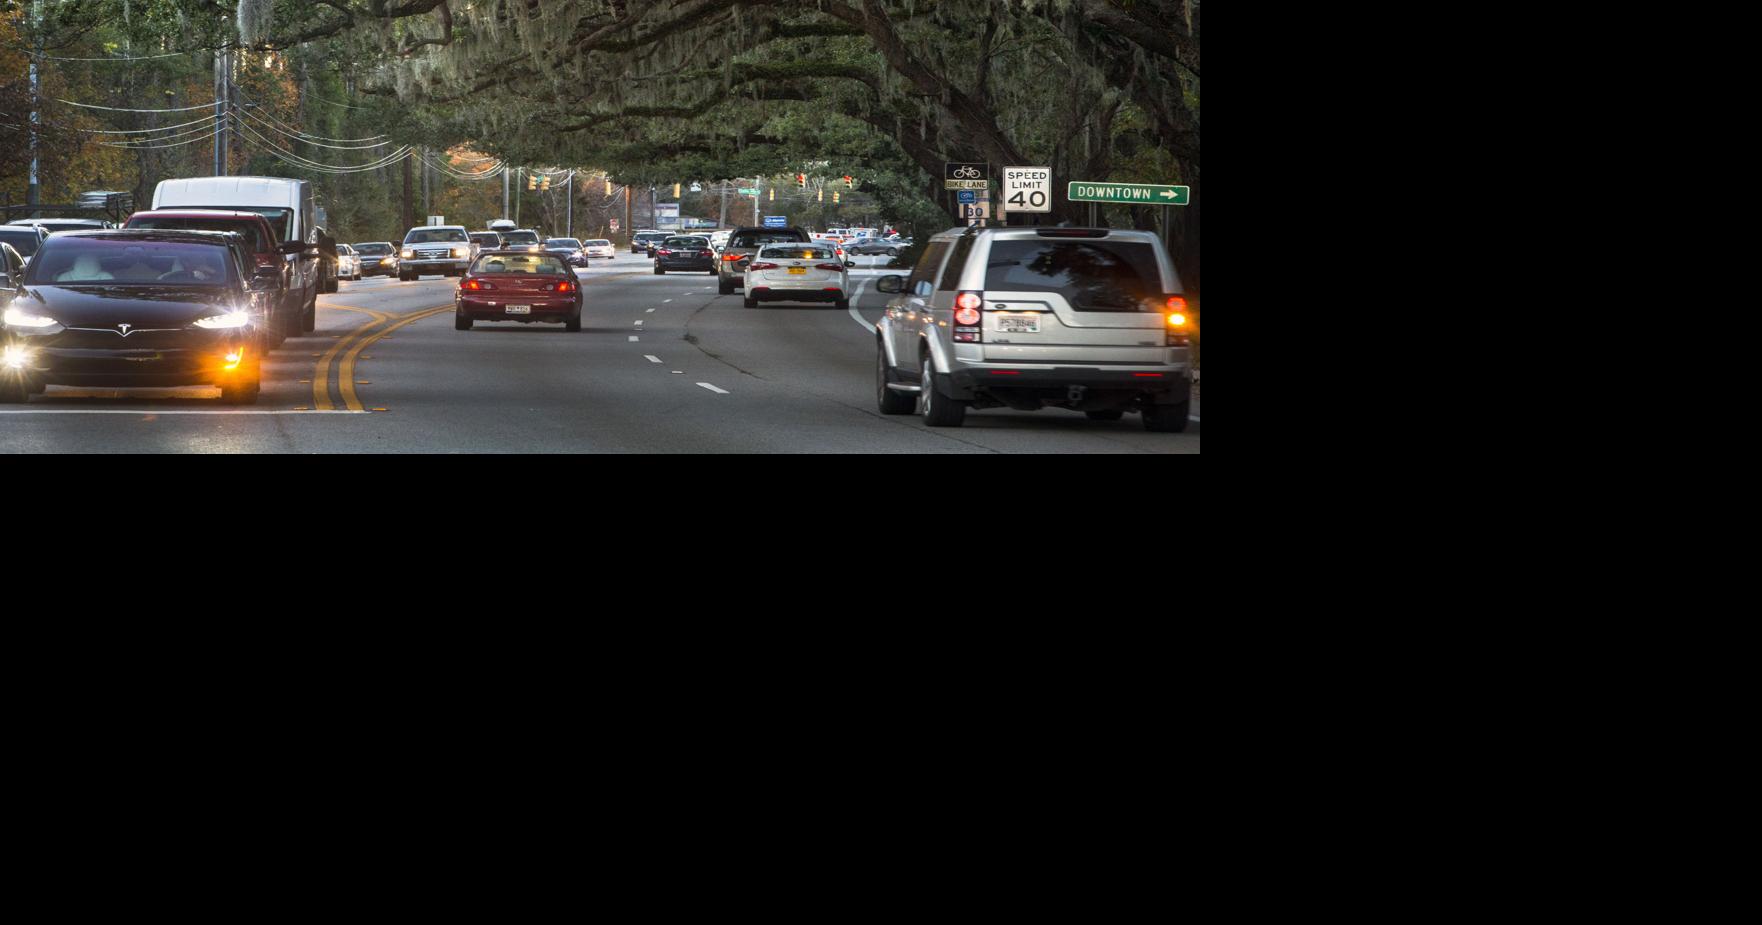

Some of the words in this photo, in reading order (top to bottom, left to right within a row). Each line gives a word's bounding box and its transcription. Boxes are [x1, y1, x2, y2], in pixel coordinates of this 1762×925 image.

[1008, 171, 1047, 180] SPEED
[947, 180, 964, 188] BIKE
[967, 180, 986, 188] LANE
[1012, 181, 1042, 189] LIMIT
[1078, 186, 1151, 199] DOWNTOWN
[1008, 190, 1046, 207] 40
